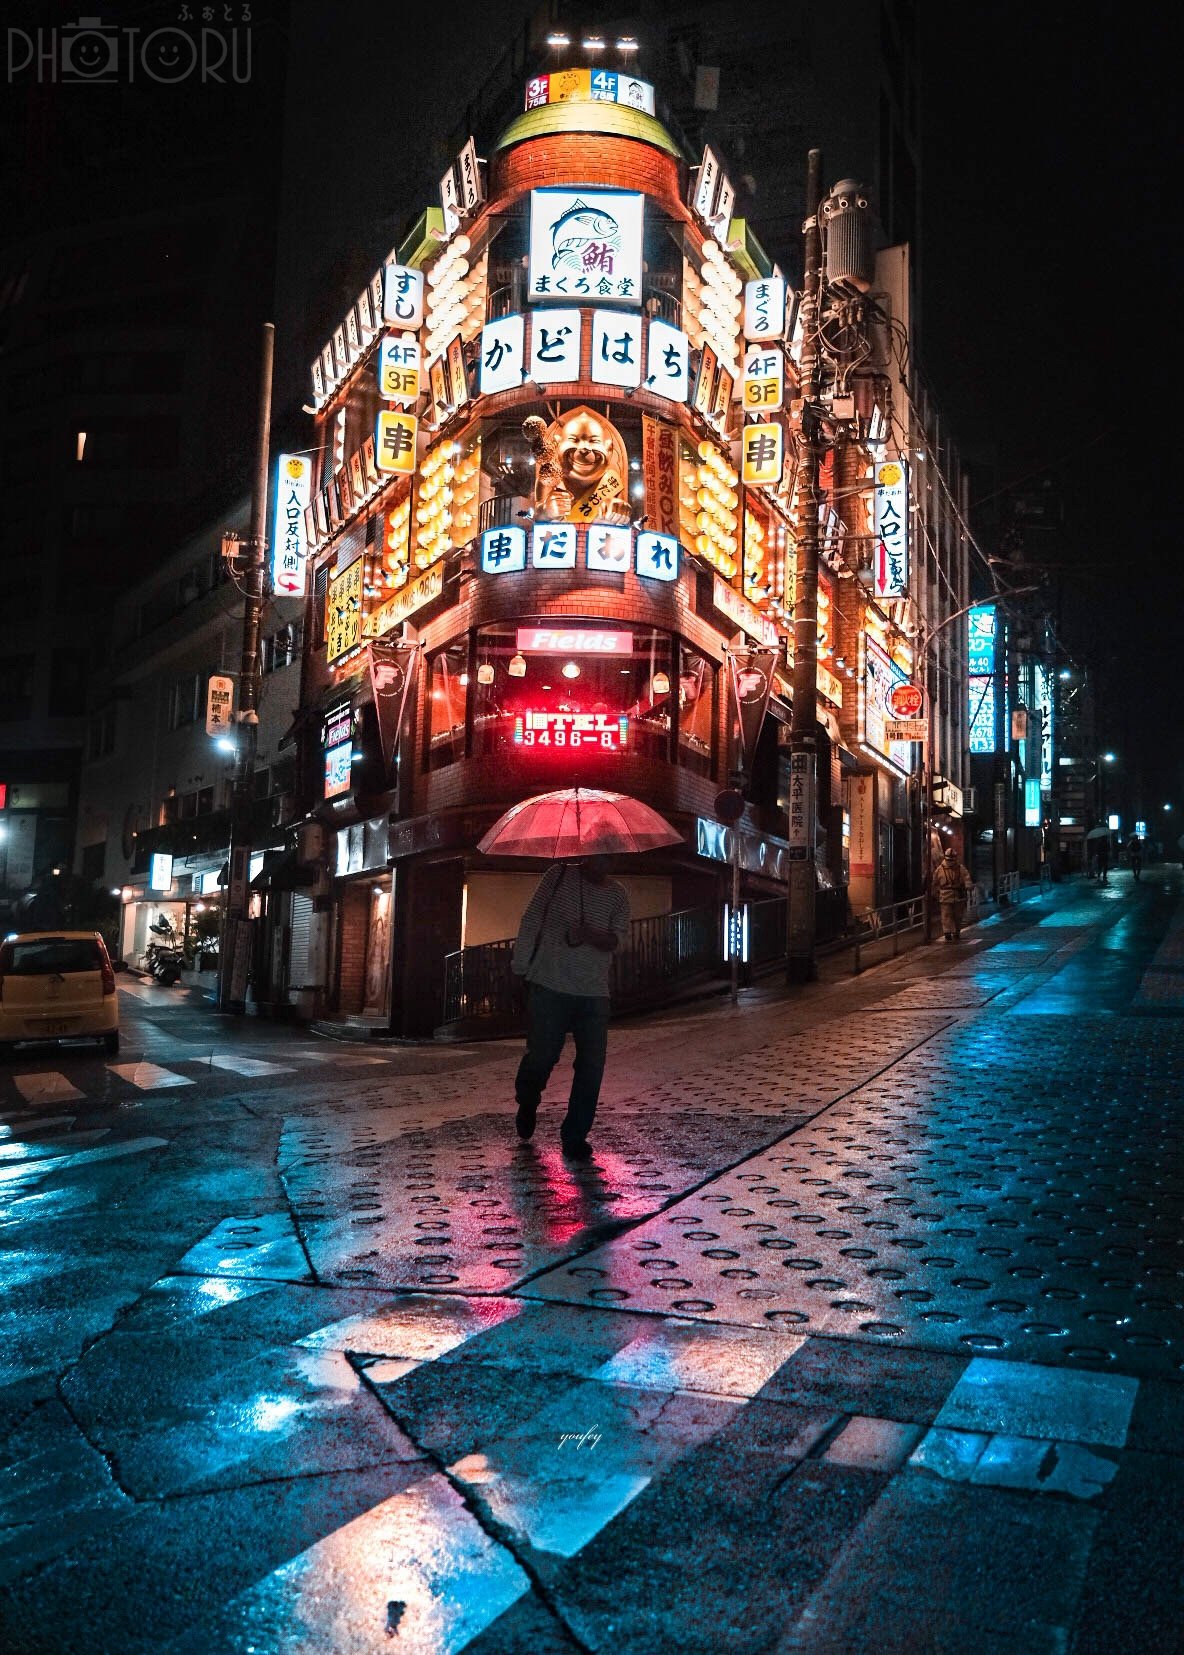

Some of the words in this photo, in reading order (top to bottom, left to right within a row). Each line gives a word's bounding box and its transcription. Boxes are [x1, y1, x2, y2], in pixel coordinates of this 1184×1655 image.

[528, 79, 548, 96] 3F
[593, 71, 616, 90] 4F
[581, 242, 614, 275] 鮪
[394, 270, 417, 320] すし
[387, 344, 416, 364] 4F
[485, 326, 682, 378] かどはち
[747, 356, 777, 376] 4F
[387, 371, 416, 391] 3F
[748, 383, 777, 404] 3F
[383, 422, 414, 460] 串
[746, 433, 777, 472] 串
[283, 489, 302, 571] 入口反対側
[531, 632, 618, 650] Fields
